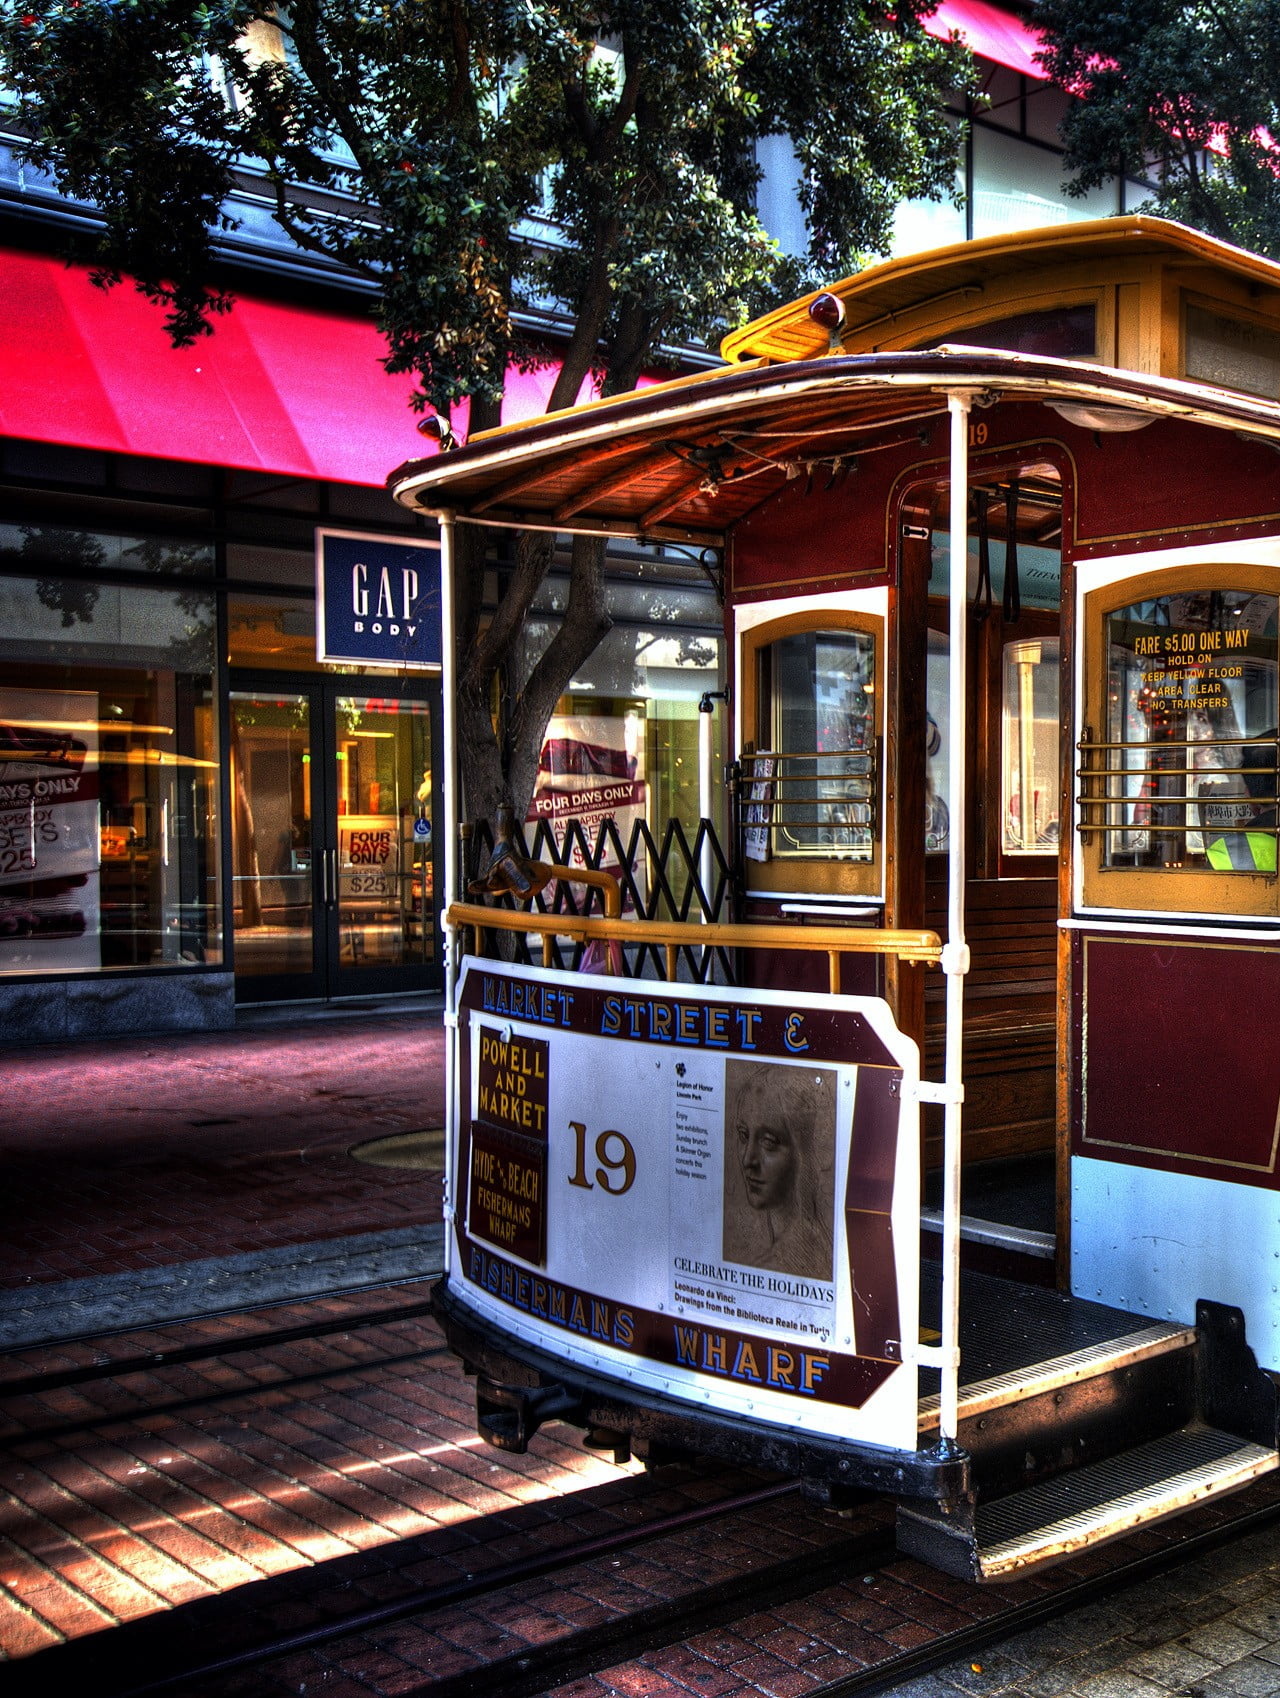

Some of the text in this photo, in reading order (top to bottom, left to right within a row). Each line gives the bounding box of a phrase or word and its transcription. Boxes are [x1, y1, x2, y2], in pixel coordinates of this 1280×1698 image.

[969, 423, 988, 446] 19
[352, 563, 418, 619] GAP
[354, 621, 417, 637] BODY
[1135, 629, 1249, 655] FARE $5.00 ONE WAY
[1168, 653, 1212, 666] HOLD ON
[1141, 666, 1243, 682] KEEP YELLOW FLOOR
[1158, 683, 1221, 697] AREA CLEAR
[1151, 697, 1229, 710] NO TRANSFERS
[34, 776, 82, 796] ONLY
[536, 785, 633, 812] FOUR DAYS ONLY
[577, 811, 616, 826] APBODY
[350, 842, 390, 853] DAYS
[351, 832, 391, 842] FOUR
[349, 853, 390, 864] ONLY
[351, 876, 386, 892] $25
[483, 977, 810, 1053] MARKET STREET &
[483, 1036, 545, 1079] POWELL
[495, 1071, 526, 1097] AND
[480, 1084, 546, 1131] MARKET
[568, 1120, 637, 1196] 19
[473, 1148, 495, 1184] HYDE
[508, 1162, 539, 1203] BEACH
[477, 1185, 531, 1229] FISHERMANS
[489, 1213, 517, 1245] WHARF
[674, 1257, 834, 1302] CELEBRATE THE HOLIDAYS
[674, 1280, 736, 1304] Leonardo da Vinci:
[470, 1247, 830, 1394] FISHERMANS WHARF
[674, 1292, 705, 1309] Drawings
[706, 1301, 722, 1313] from
[723, 1304, 735, 1316] the
[736, 1307, 774, 1325] Biblioteca
[775, 1317, 798, 1330] Reale
[799, 1321, 808, 1332] in
